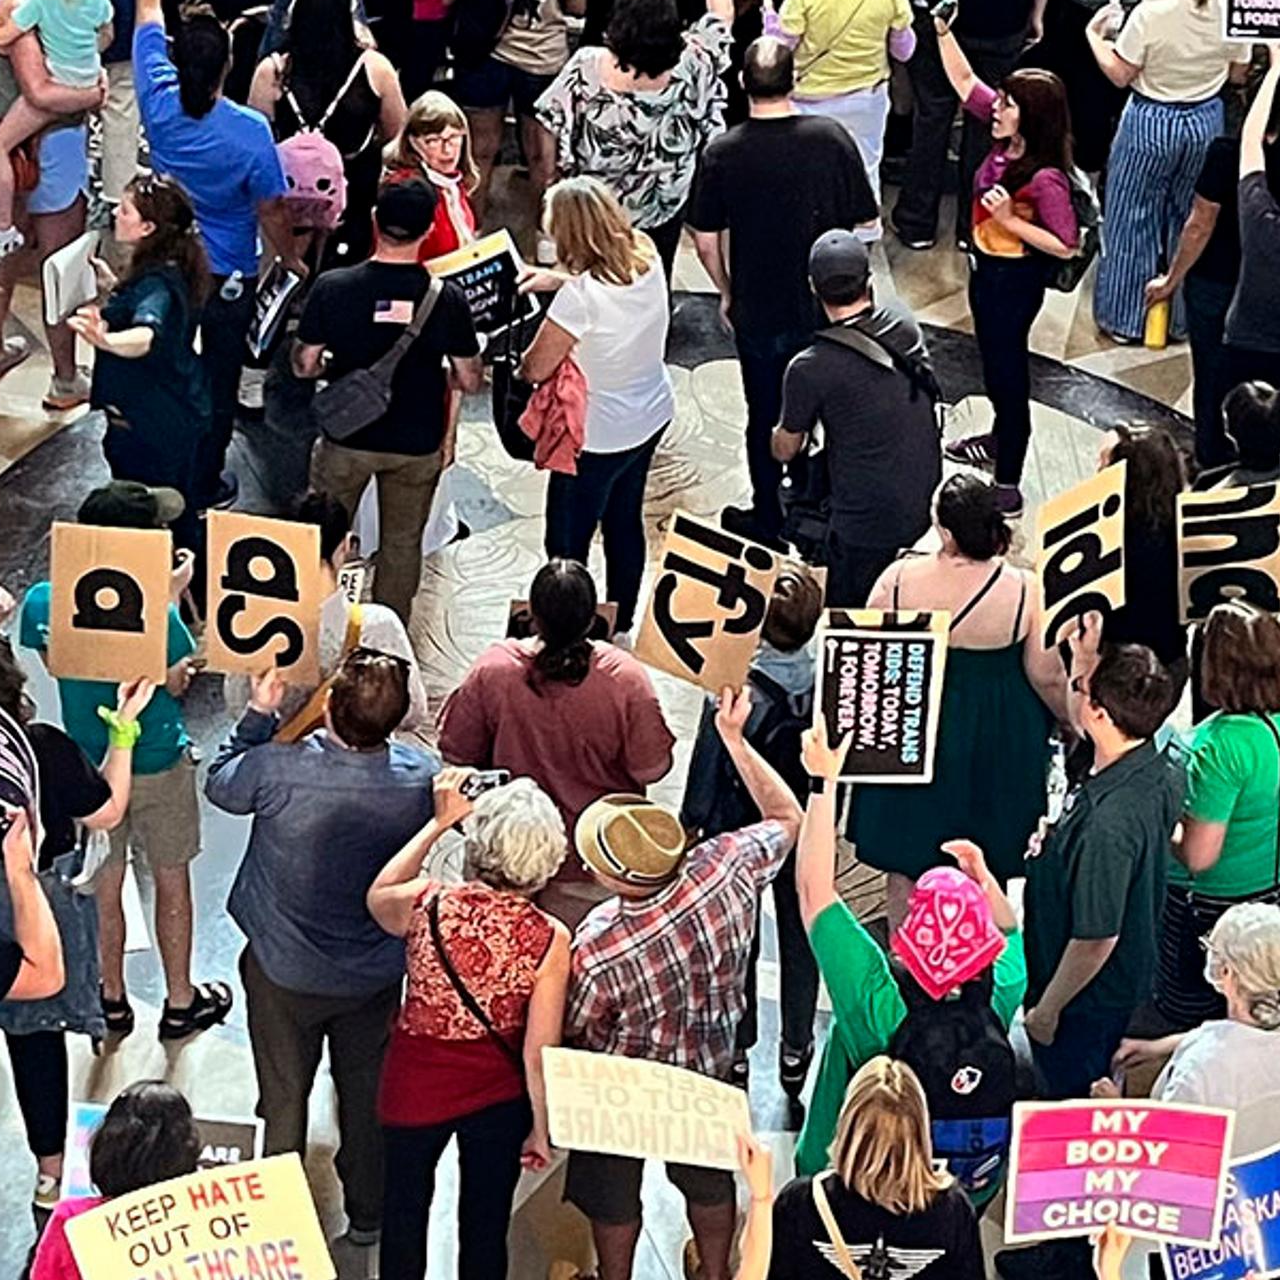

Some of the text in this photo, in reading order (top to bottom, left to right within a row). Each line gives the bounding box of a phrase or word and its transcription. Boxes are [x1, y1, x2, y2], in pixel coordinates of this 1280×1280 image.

[1232, 12, 1241, 24] &
[841, 642, 858, 654] &
[854, 642, 883, 751] TOMORROW,
[878, 642, 903, 751] KIDS: TODAY,
[900, 644, 926, 765] DEFEND TRANS
[1091, 1109, 1150, 1134] MY
[1065, 1139, 1169, 1167] BODY
[1083, 1170, 1142, 1195] MY
[106, 1172, 266, 1241] KEEP HATE
[1041, 1197, 1180, 1232] CHOICE
[128, 1210, 252, 1268] OUT OF
